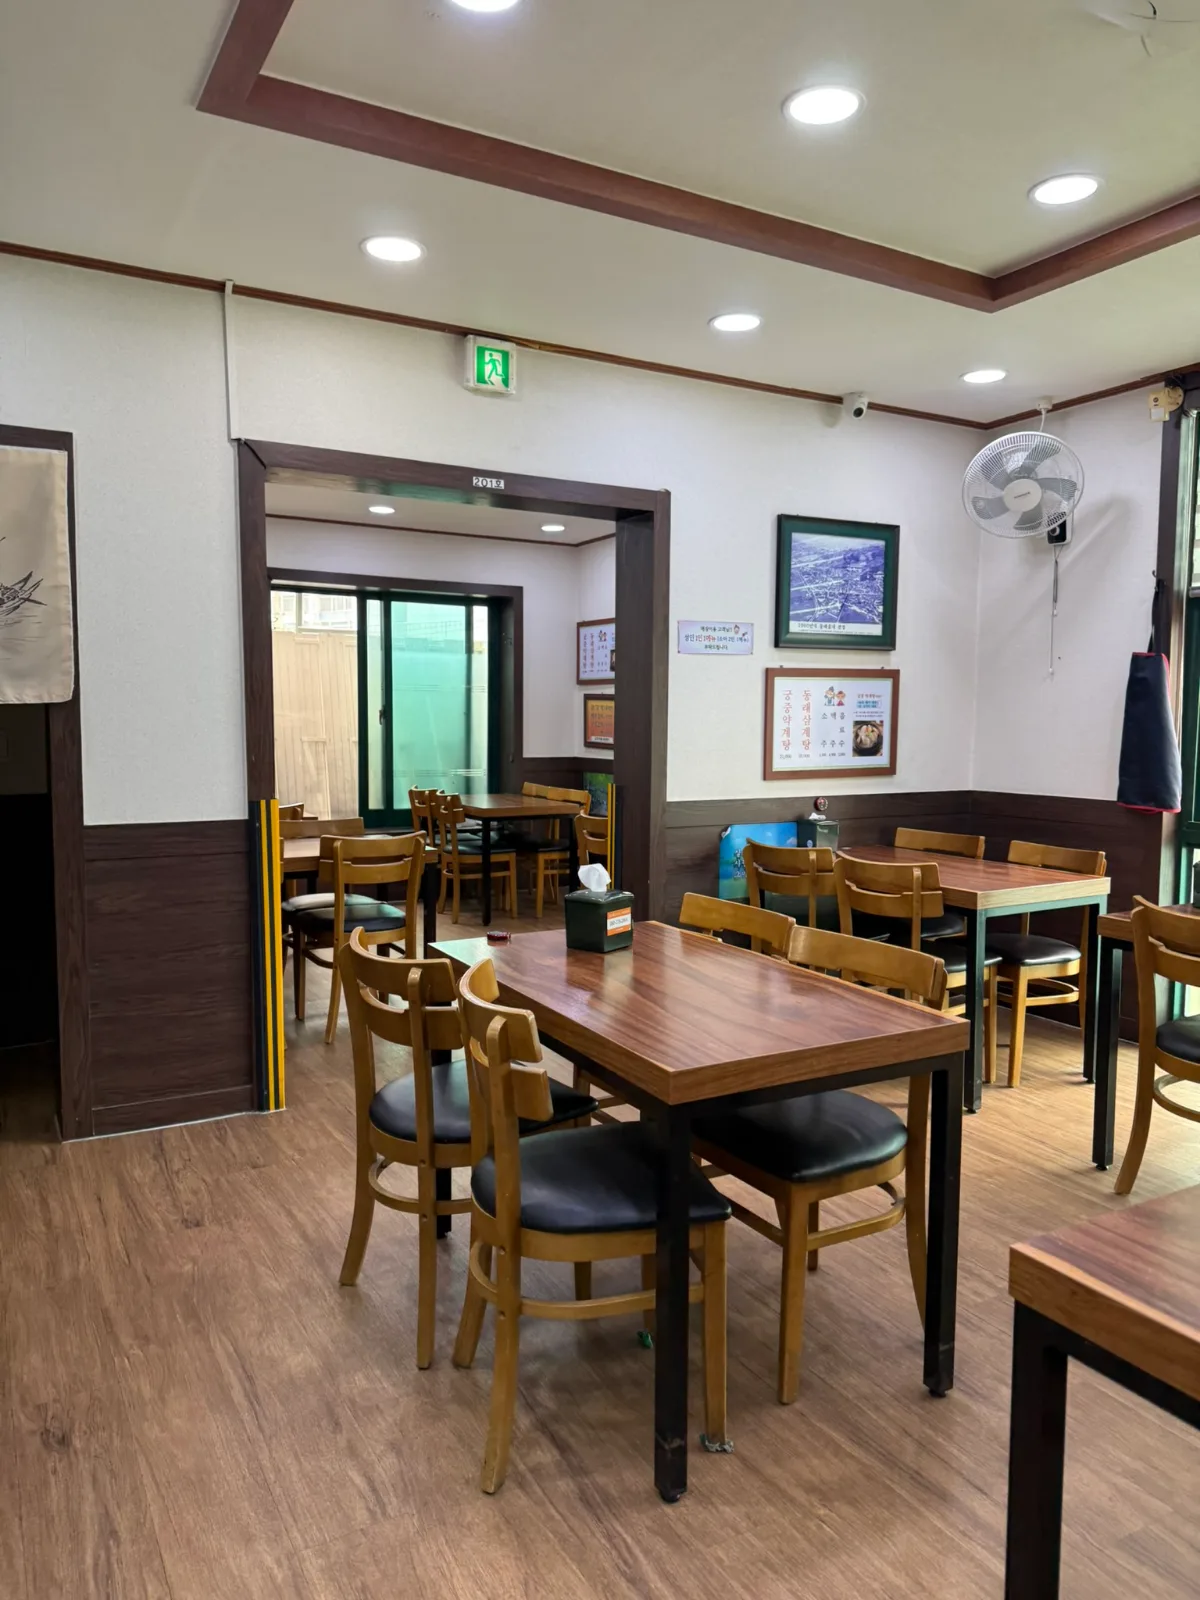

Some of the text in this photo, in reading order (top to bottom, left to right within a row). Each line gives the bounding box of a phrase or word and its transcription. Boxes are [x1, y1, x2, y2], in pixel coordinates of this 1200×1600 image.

[474, 477, 503, 488] 201호
[684, 634, 694, 642] 성인
[695, 634, 702, 642] 1인
[782, 689, 792, 751] 궁중약계탕
[802, 689, 812, 751] 동래삼계탕
